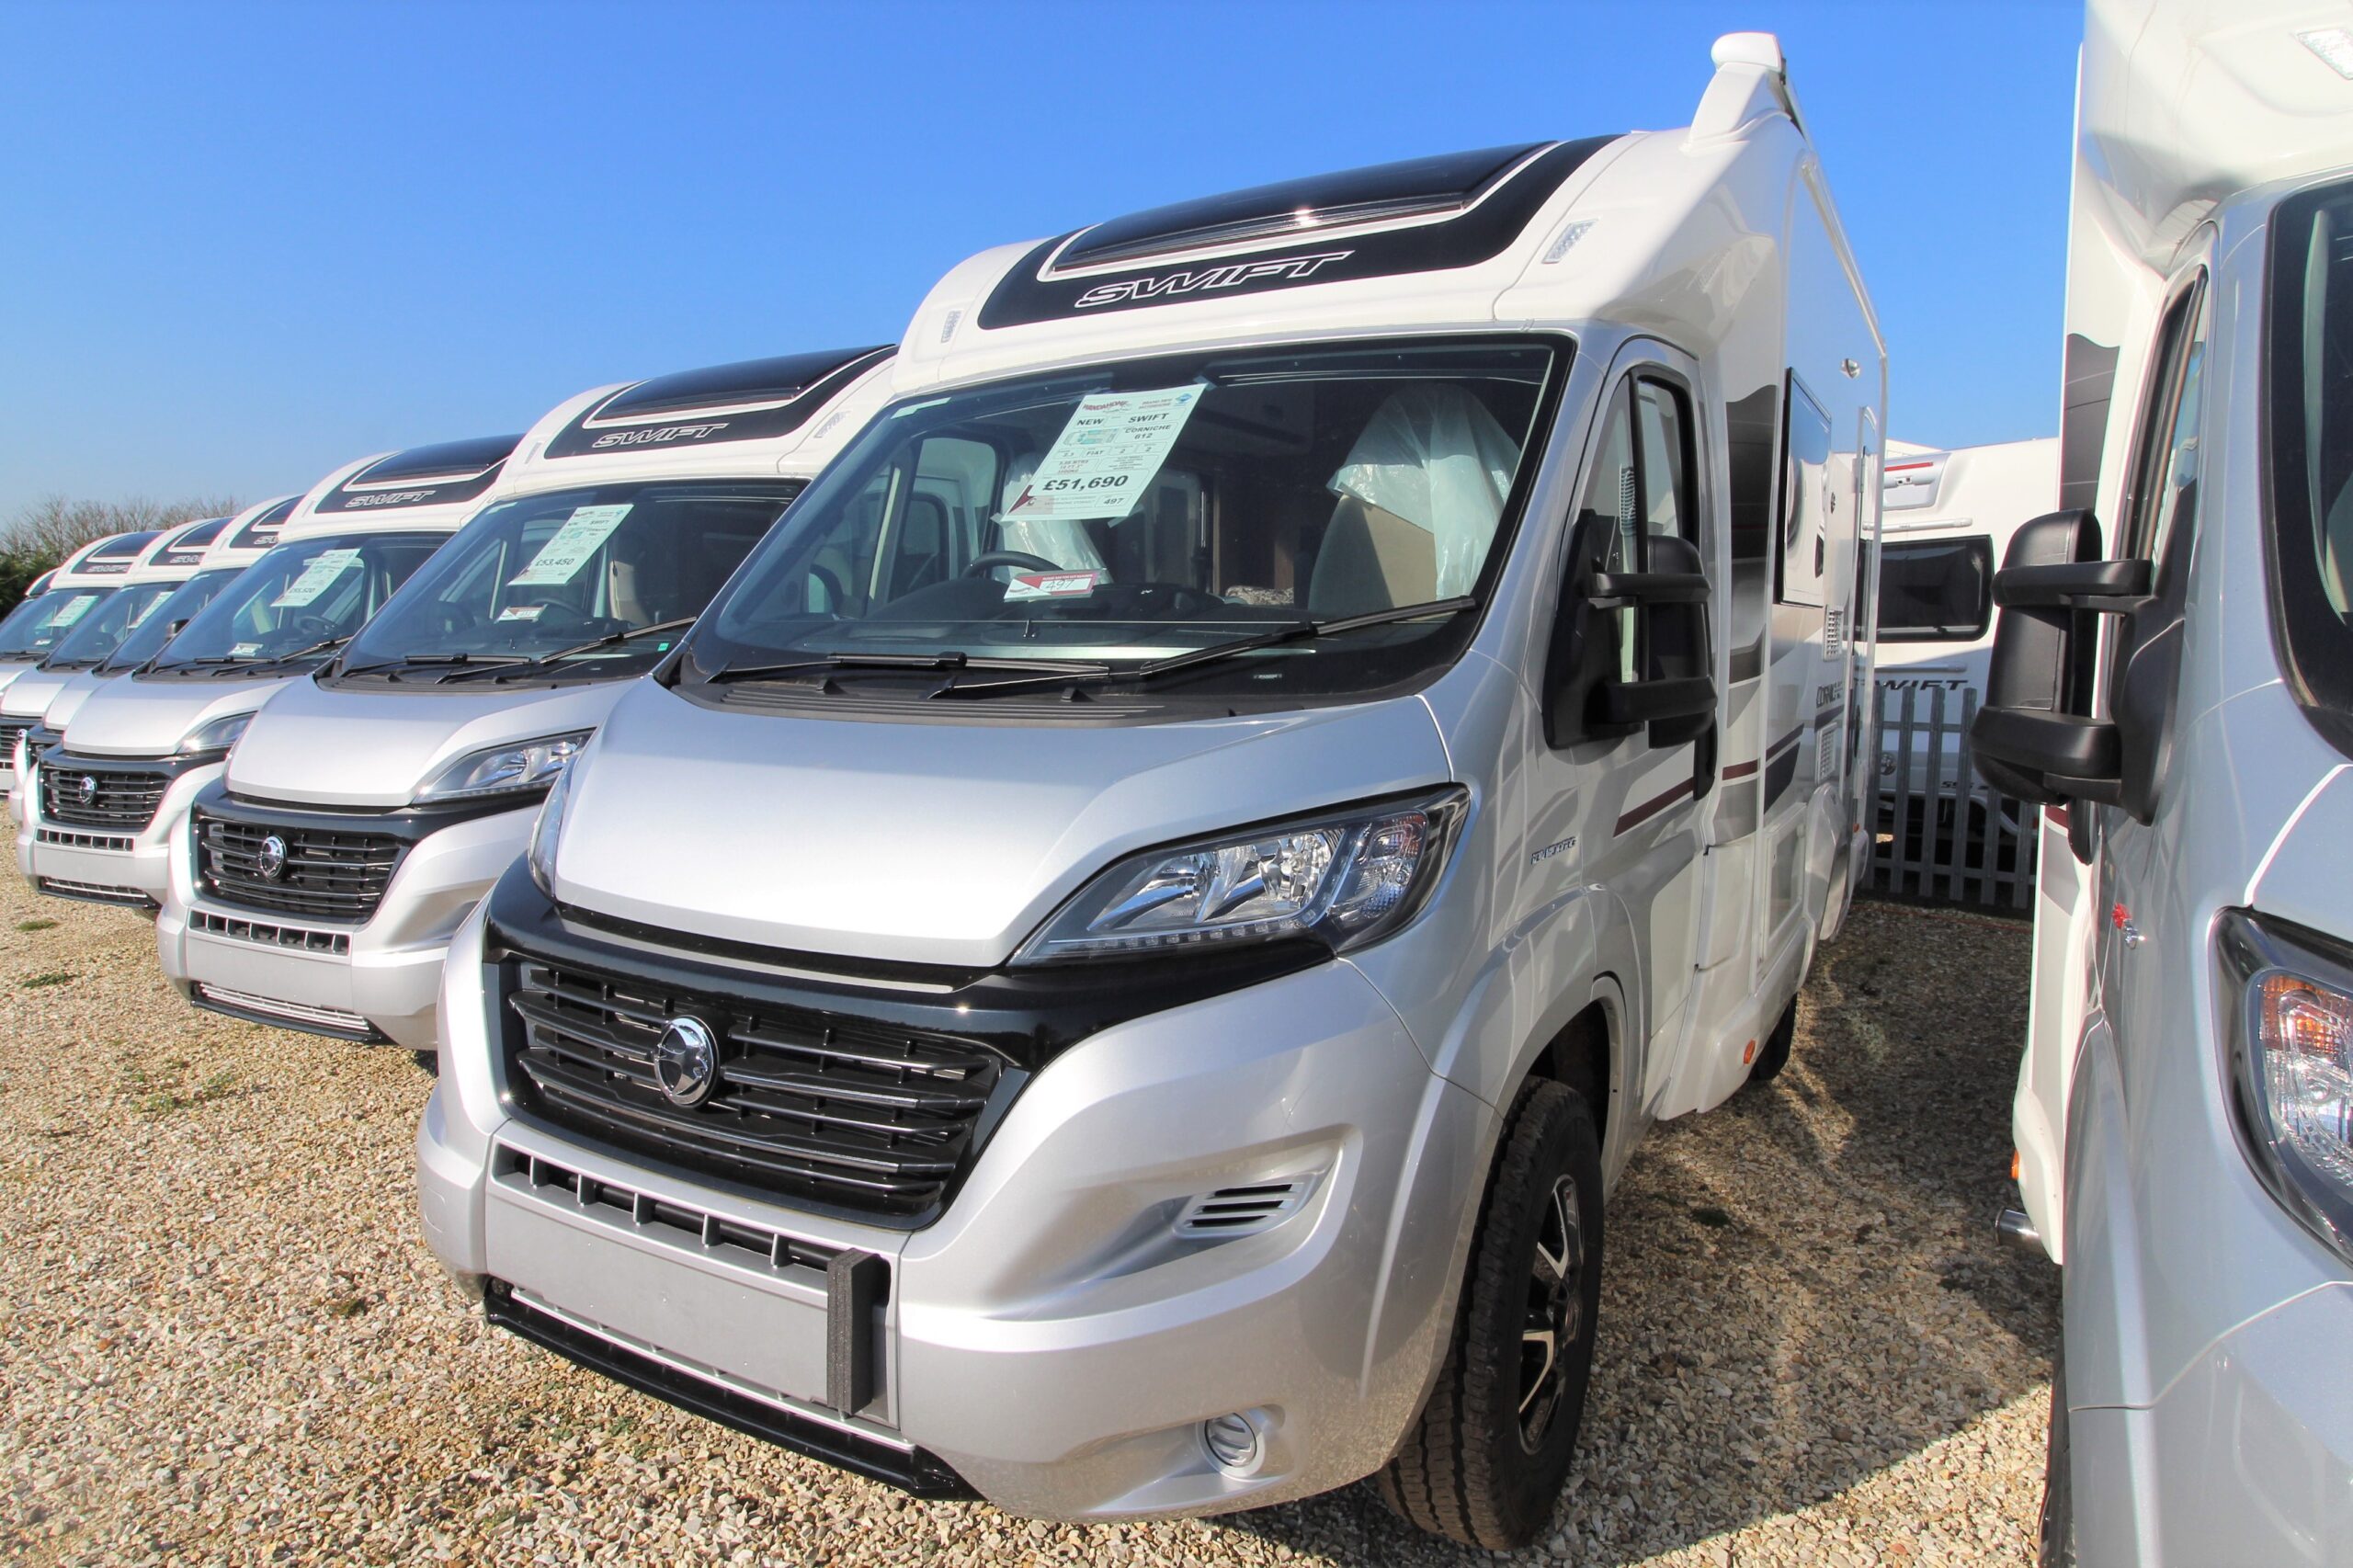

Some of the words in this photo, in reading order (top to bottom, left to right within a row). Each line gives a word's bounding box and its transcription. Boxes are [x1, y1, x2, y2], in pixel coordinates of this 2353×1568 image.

[1074, 249, 1356, 308] SWIFT
[1076, 418, 1105, 426] NEW
[1128, 412, 1169, 424] SWIFT
[1125, 424, 1172, 434] CORNICHE
[591, 423, 730, 449] SWIFT
[1042, 474, 1129, 492] £51,690
[345, 490, 437, 508] SWIFT
[1103, 497, 1124, 506] 497
[1855, 679, 1969, 690] WIFT
